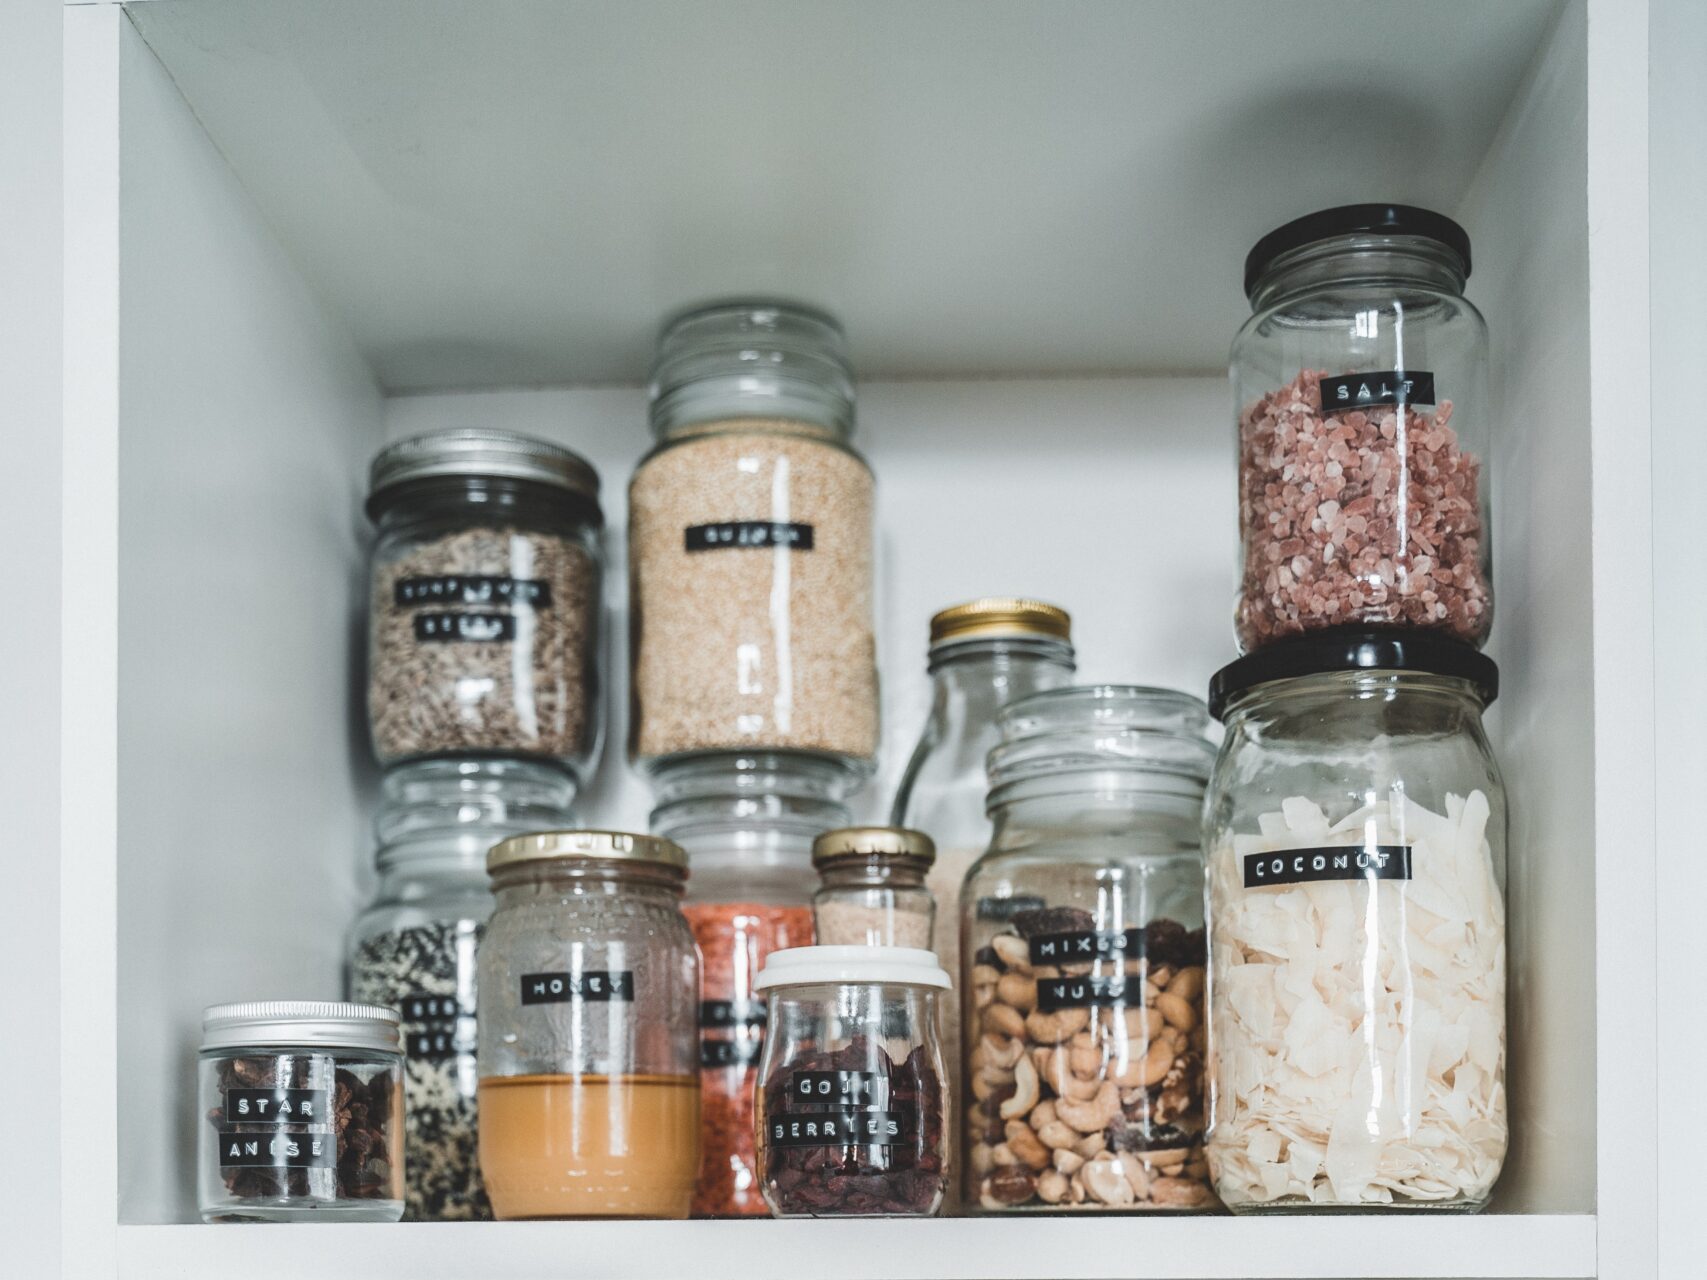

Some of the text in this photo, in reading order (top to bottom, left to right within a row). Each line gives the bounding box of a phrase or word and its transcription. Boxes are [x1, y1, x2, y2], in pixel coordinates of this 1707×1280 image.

[1336, 380, 1415, 399] SALT
[1255, 853, 1390, 877] COCONUT
[1040, 934, 1128, 956] MIXED
[533, 977, 623, 995] HONEY
[1053, 984, 1125, 999] NUTS
[800, 1079, 870, 1094] GOJI
[238, 1098, 313, 1116] STAR
[775, 1120, 899, 1139] BERRIES
[229, 1140, 322, 1157] ANISE
